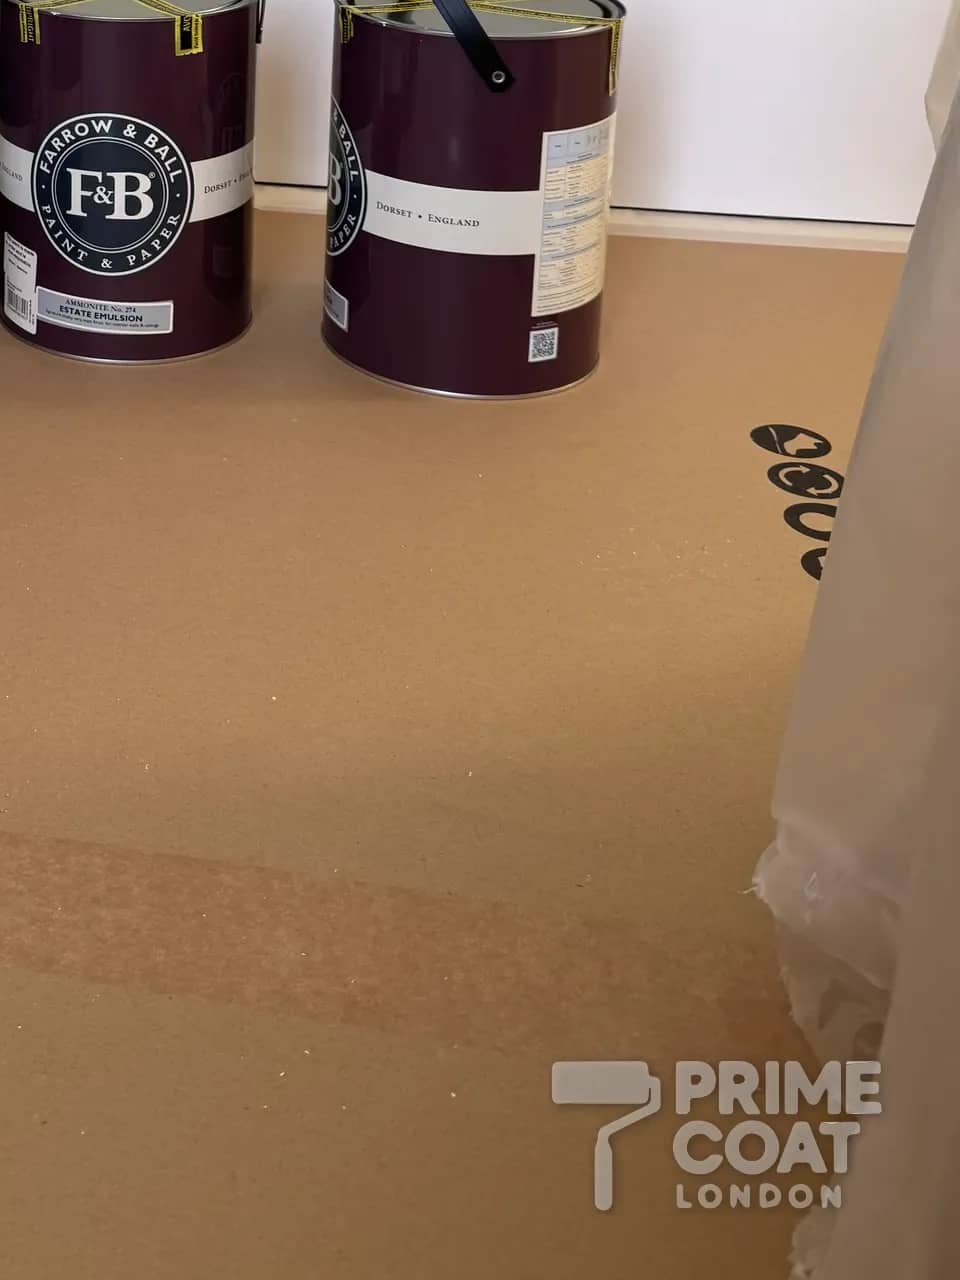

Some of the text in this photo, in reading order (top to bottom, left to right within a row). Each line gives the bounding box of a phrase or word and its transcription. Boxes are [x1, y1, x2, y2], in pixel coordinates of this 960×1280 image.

[40, 120, 183, 183] FARROW & BALL
[339, 123, 359, 183] BALL
[66, 167, 154, 220] F&B
[376, 200, 480, 227] DORSET ENGLAND
[41, 205, 89, 262] PAINT
[100, 258, 112, 269] &
[126, 214, 181, 266] PAPER
[59, 305, 92, 319] ESTATE
[94, 312, 143, 322] EMULSION
[65, 299, 109, 312] AMMONITE
